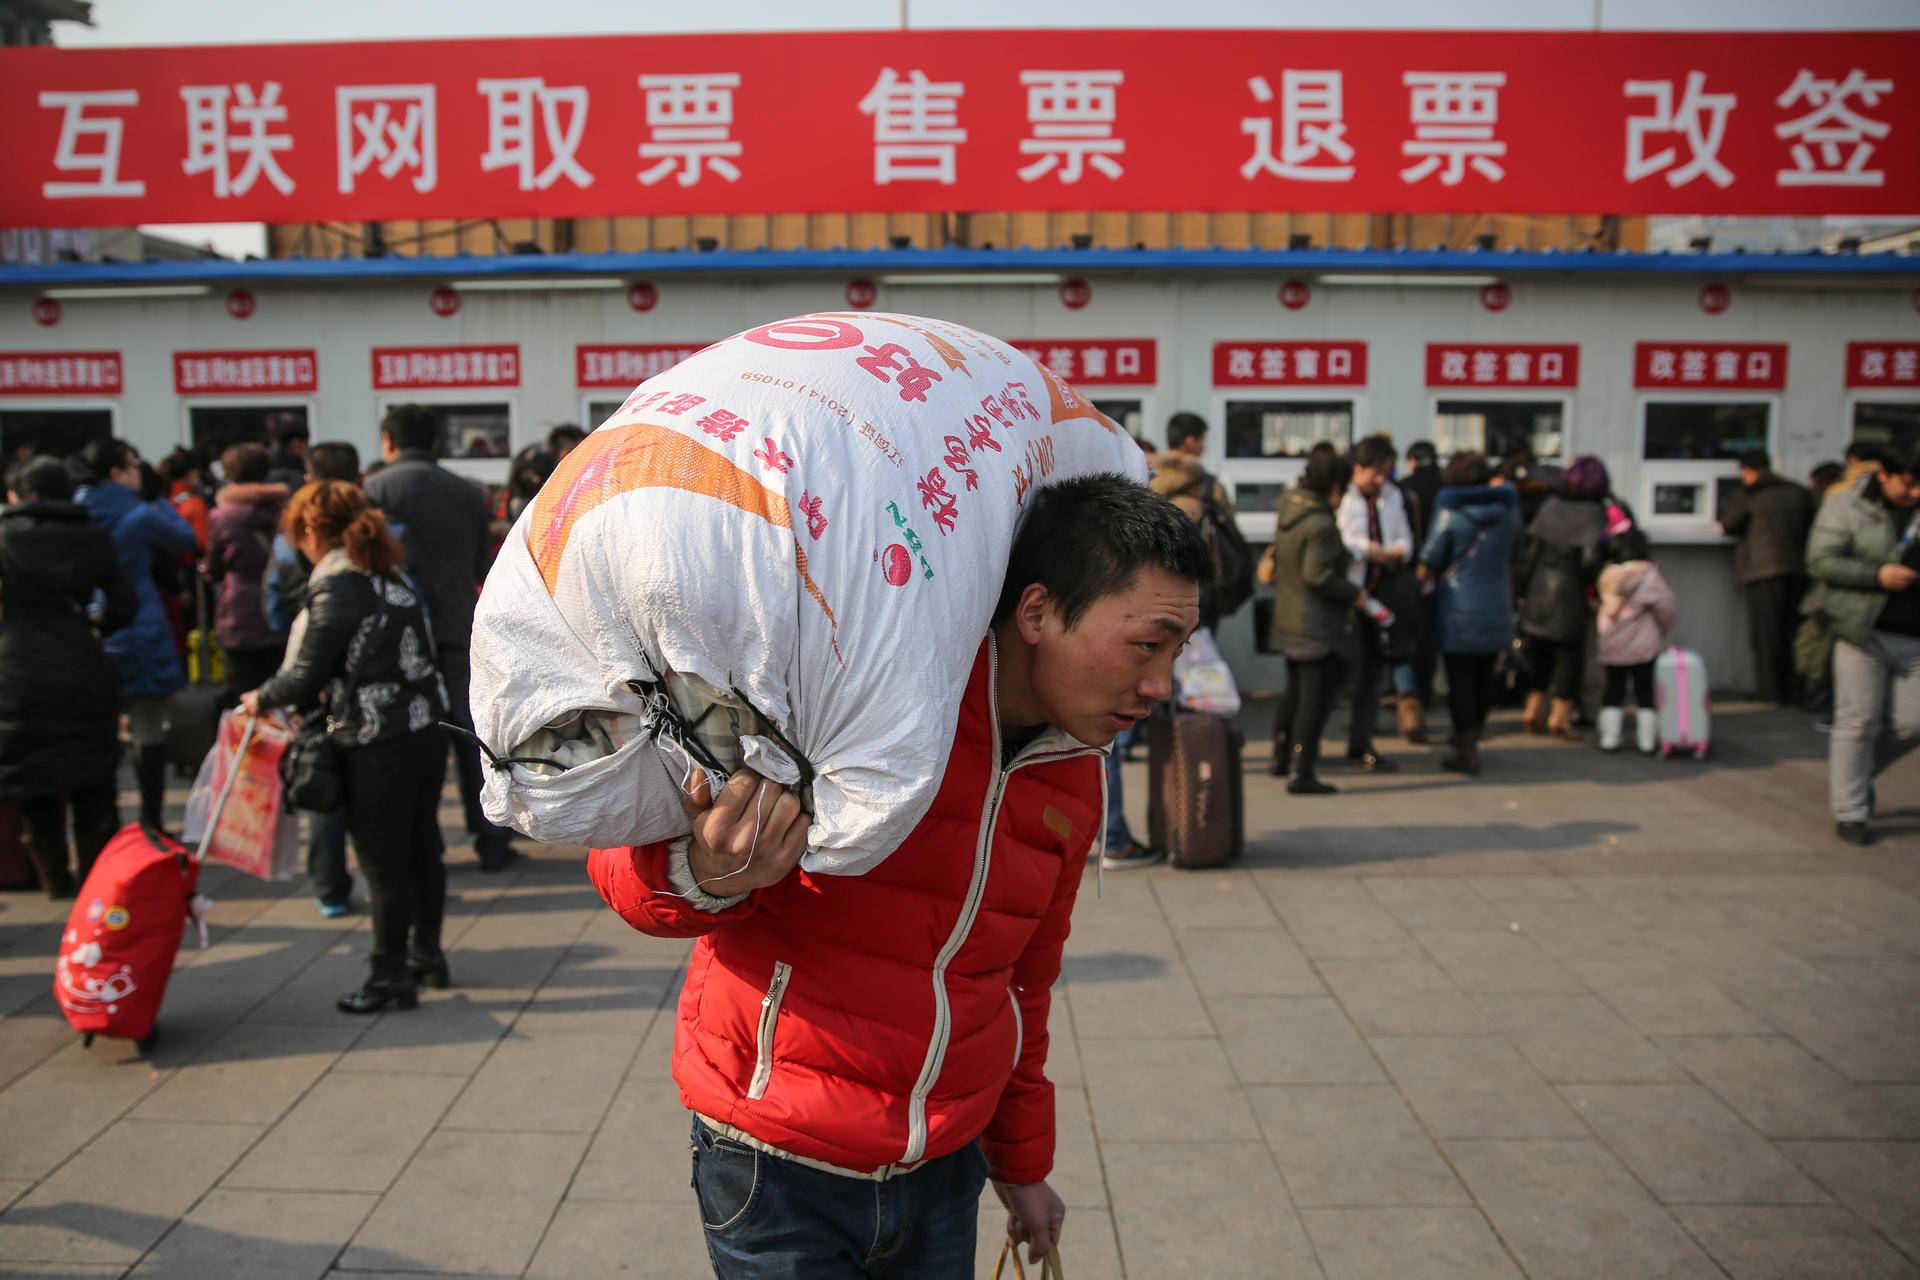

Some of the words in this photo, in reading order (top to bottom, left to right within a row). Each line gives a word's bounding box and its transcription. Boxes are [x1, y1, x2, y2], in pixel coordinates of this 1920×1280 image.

[38, 73, 744, 199] 互联网取票
[858, 67, 1125, 185] 售票
[1240, 68, 1508, 187] 退票
[1622, 68, 1895, 189] 改签
[855, 342, 942, 403] 好
[1227, 347, 1352, 380] 改签窗口
[1440, 349, 1565, 383] 改签窗口
[1647, 349, 1773, 382] 改签窗口
